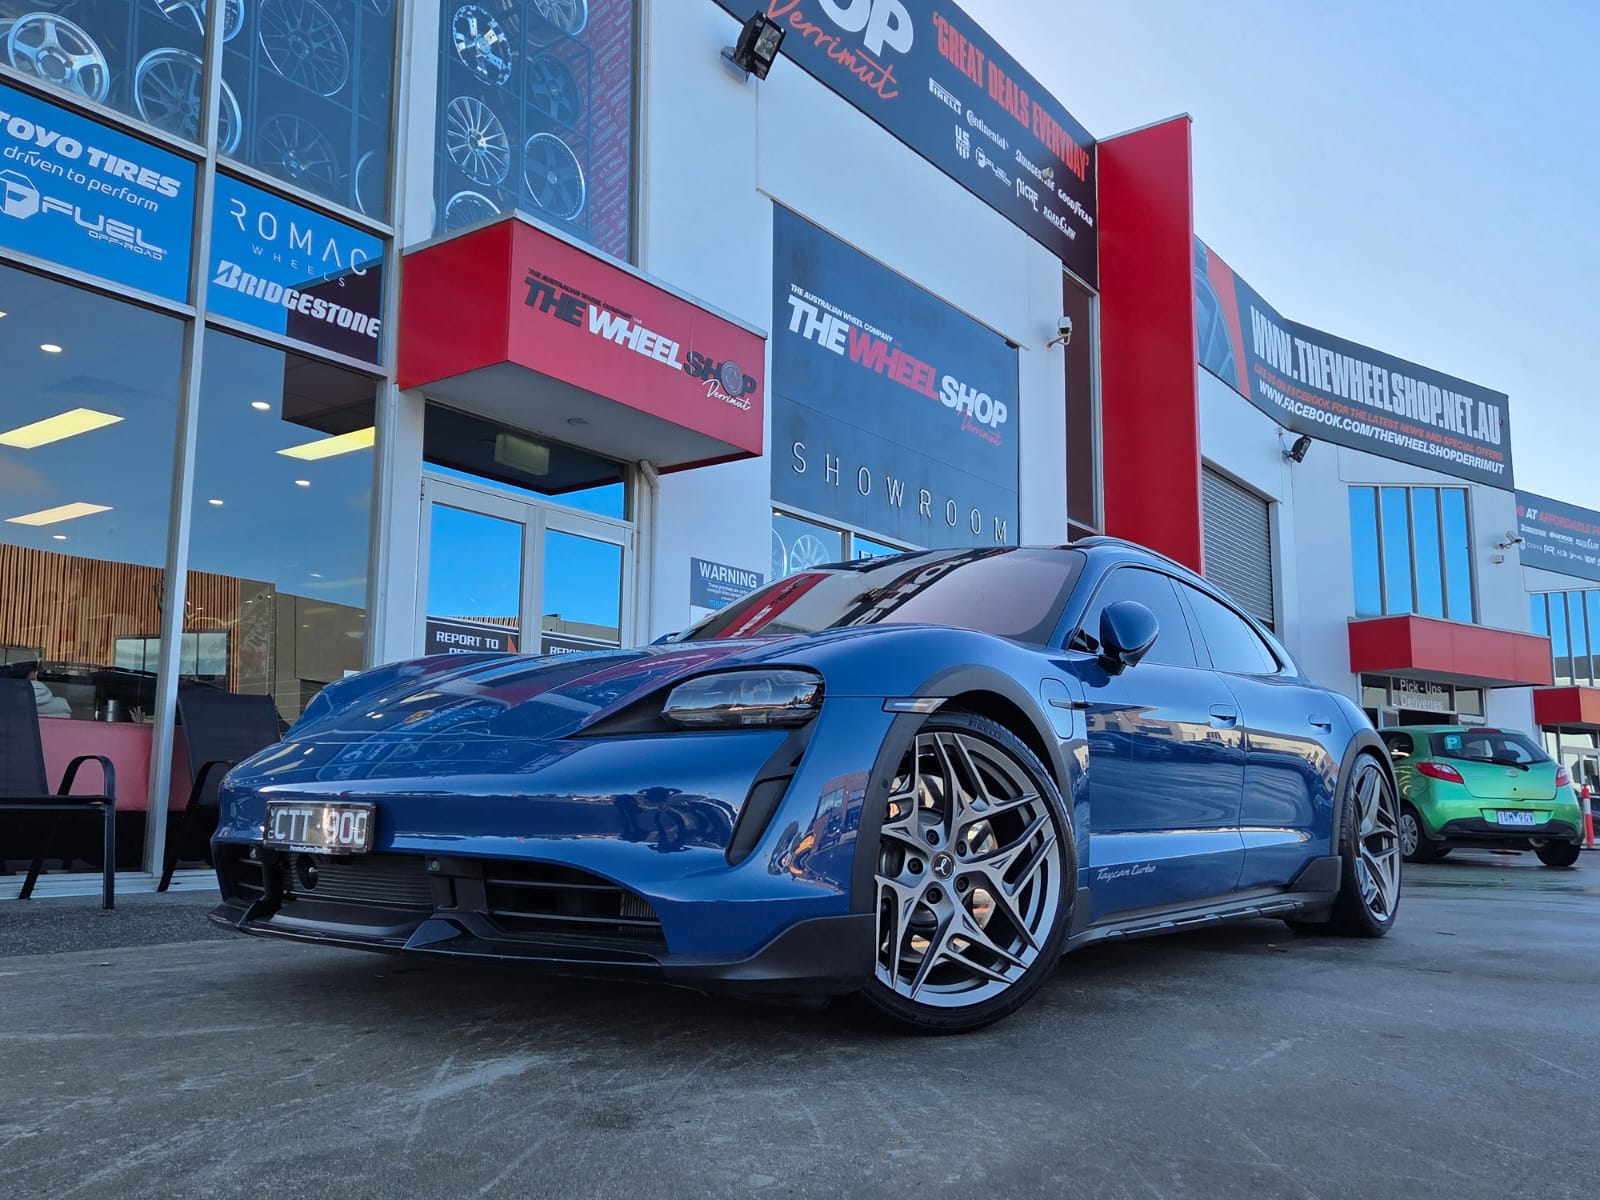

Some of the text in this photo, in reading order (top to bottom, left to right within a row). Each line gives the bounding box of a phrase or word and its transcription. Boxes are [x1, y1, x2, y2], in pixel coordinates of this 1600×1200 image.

[929, 77, 962, 115] PIRELLI
[988, 59, 1030, 129] DEALS
[3, 146, 159, 213] driven to perform
[87, 146, 181, 199] TIRES
[41, 195, 163, 254] FUEL
[1058, 189, 1094, 227] GOODYEAR
[229, 198, 368, 277] ROMAC
[251, 244, 347, 288] WHEELS
[212, 259, 382, 339] BRIDGESTONE
[524, 277, 587, 328] THE
[588, 304, 683, 370] WHEEL
[791, 283, 894, 343] THE AUSTRALIAN WHEEL COMPANY
[788, 294, 1008, 428] THE WHEEL SHOP
[1250, 305, 1502, 445] WWW.THEWHEELSHOP.NET.AU
[702, 379, 751, 411] Derrimut
[1287, 383, 1331, 410] FACEBOOK
[1331, 402, 1349, 415] FOR
[1350, 407, 1369, 420] THE
[1369, 413, 1400, 430] LATEST
[1400, 423, 1425, 438] NEWS
[1425, 430, 1443, 444] AND
[1443, 436, 1475, 454] SPECIAL
[1259, 379, 1505, 475] WWW.FACEBOOK.COM/THEWHEELSHOPDERRIMUT
[791, 441, 1008, 545] SHOWROOM
[1526, 508, 1538, 520] AT
[699, 561, 757, 588] WARNING
[436, 631, 499, 649] REPORT TO
[1400, 679, 1420, 693] Pick
[1425, 681, 1442, 695] Ups
[1400, 694, 1444, 711] Deliveries
[1446, 737, 1458, 750] P
[274, 809, 313, 841] CTT
[1097, 867, 1130, 882] Taycan
